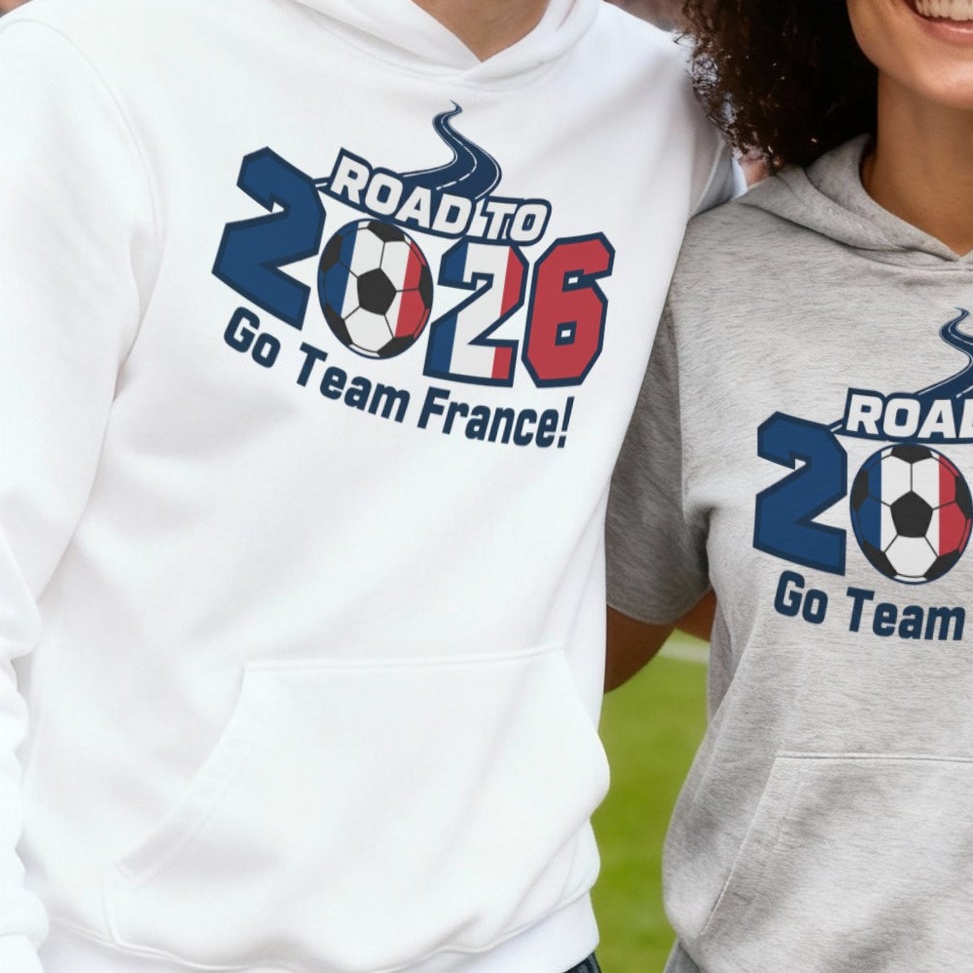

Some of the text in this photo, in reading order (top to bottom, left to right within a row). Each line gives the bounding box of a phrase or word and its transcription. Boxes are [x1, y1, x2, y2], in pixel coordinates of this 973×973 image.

[329, 150, 551, 245] ROAD TO
[211, 146, 616, 388] 2026
[223, 306, 575, 448] Go Team France!
[774, 570, 828, 625] Go
[846, 586, 966, 641] Team
